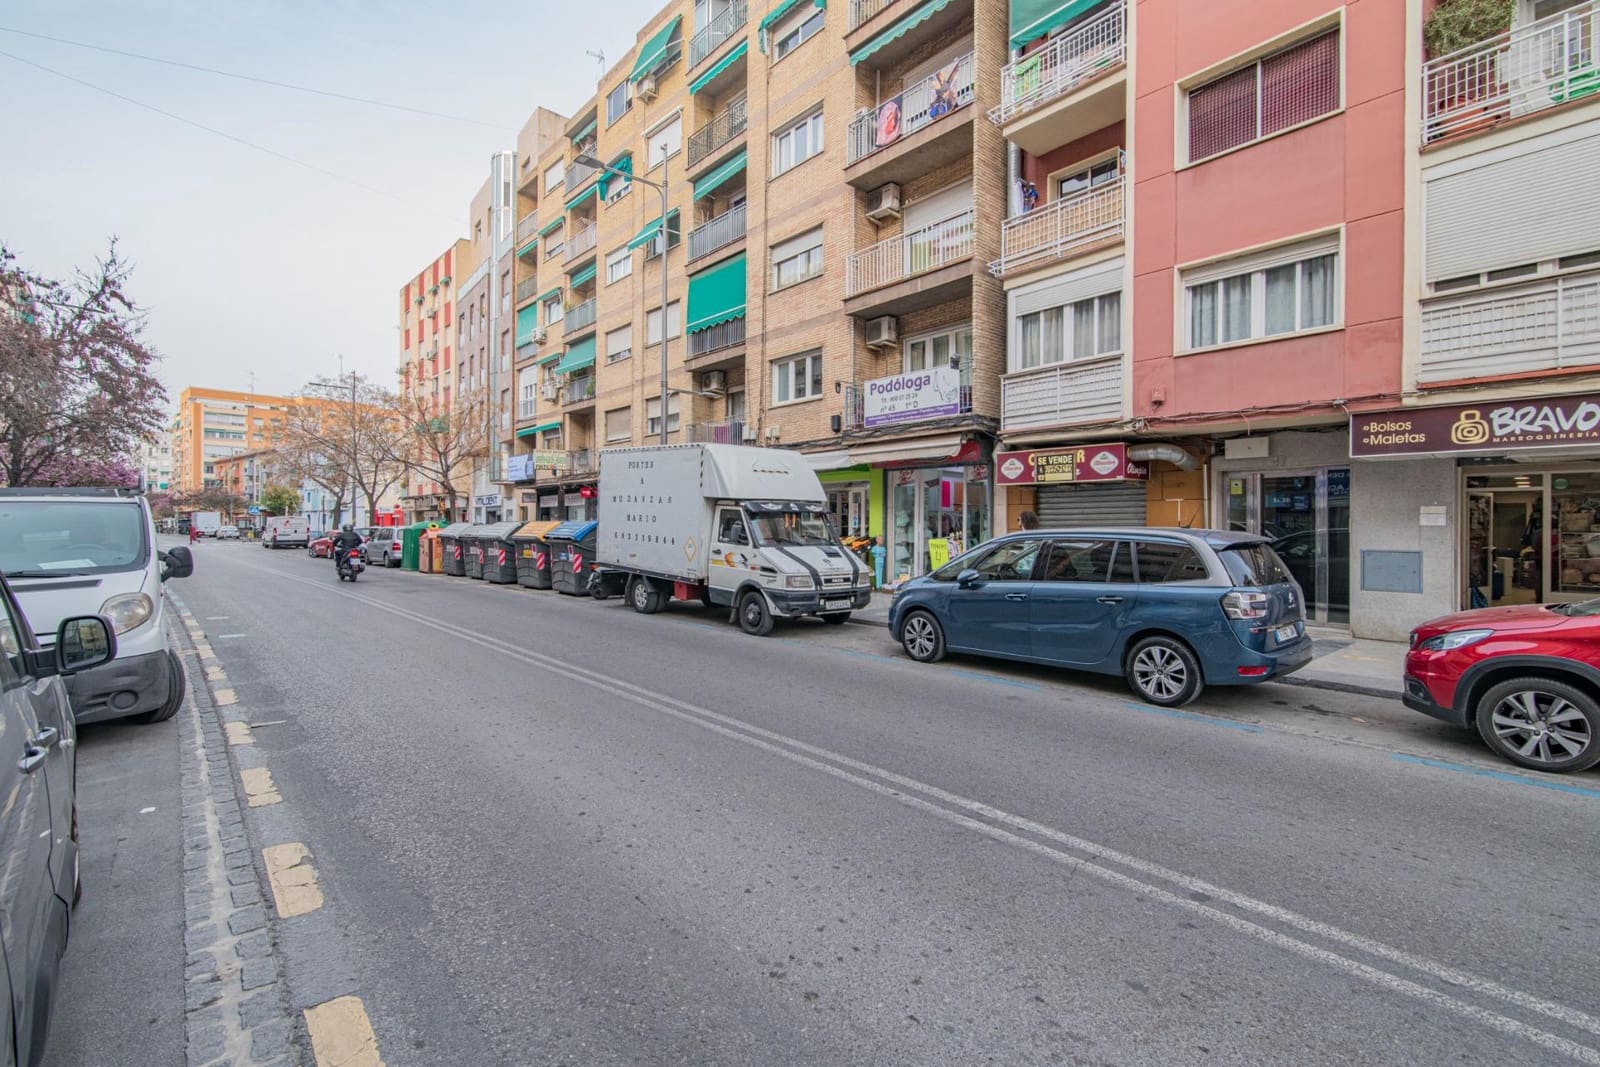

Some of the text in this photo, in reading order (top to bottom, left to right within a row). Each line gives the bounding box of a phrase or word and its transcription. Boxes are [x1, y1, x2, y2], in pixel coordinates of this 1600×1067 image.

[870, 375, 931, 396] Podóloga
[1490, 402, 1600, 437] BRAVO
[1370, 420, 1411, 433] Bolsos
[1370, 432, 1425, 446] Maletas
[1493, 431, 1599, 443] MARROQUINERÍA
[628, 461, 653, 469] PORTES
[1037, 457, 1047, 465] SE
[1048, 455, 1072, 465] VENDE
[613, 496, 672, 504] MUDANZAS
[627, 514, 656, 523] MARIO
